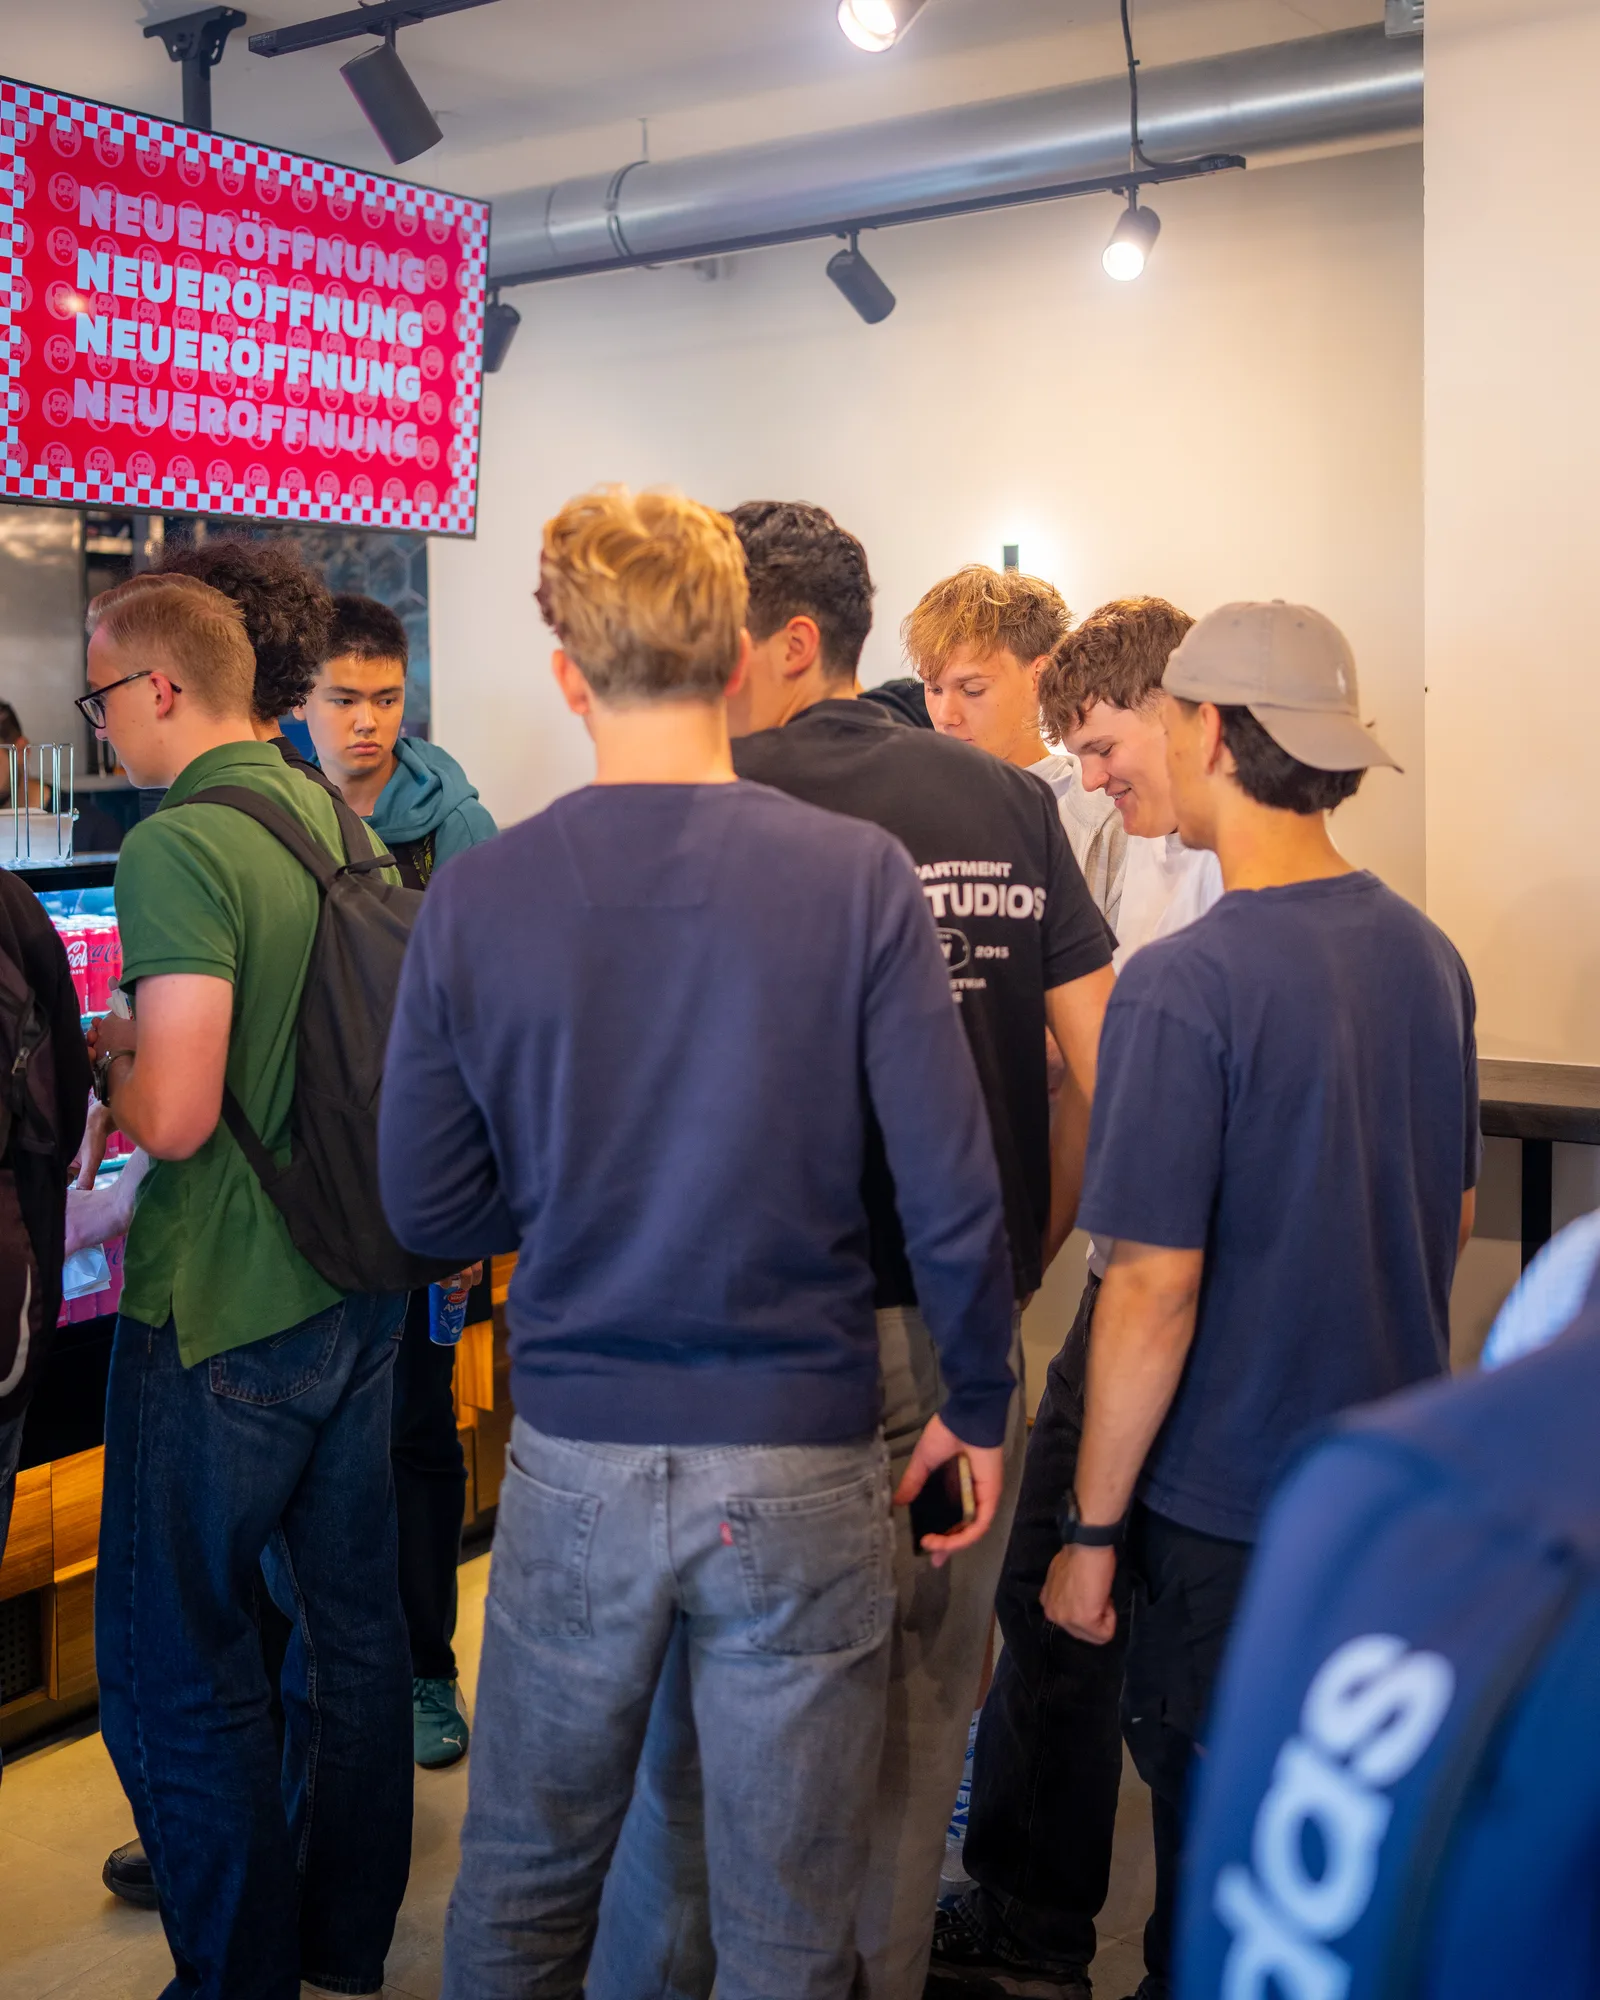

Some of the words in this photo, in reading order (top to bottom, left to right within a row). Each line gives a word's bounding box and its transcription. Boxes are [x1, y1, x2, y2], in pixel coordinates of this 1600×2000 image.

[78, 185, 426, 295] NEUERÖFFNUNG
[76, 248, 424, 349] NEUERÖFFNUNG
[74, 312, 422, 403] NEUERÖFFNUNG
[73, 378, 418, 459] NEUERÖFFNUNG
[922, 882, 1047, 921] TUDIOS
[974, 945, 1010, 959] 2015
